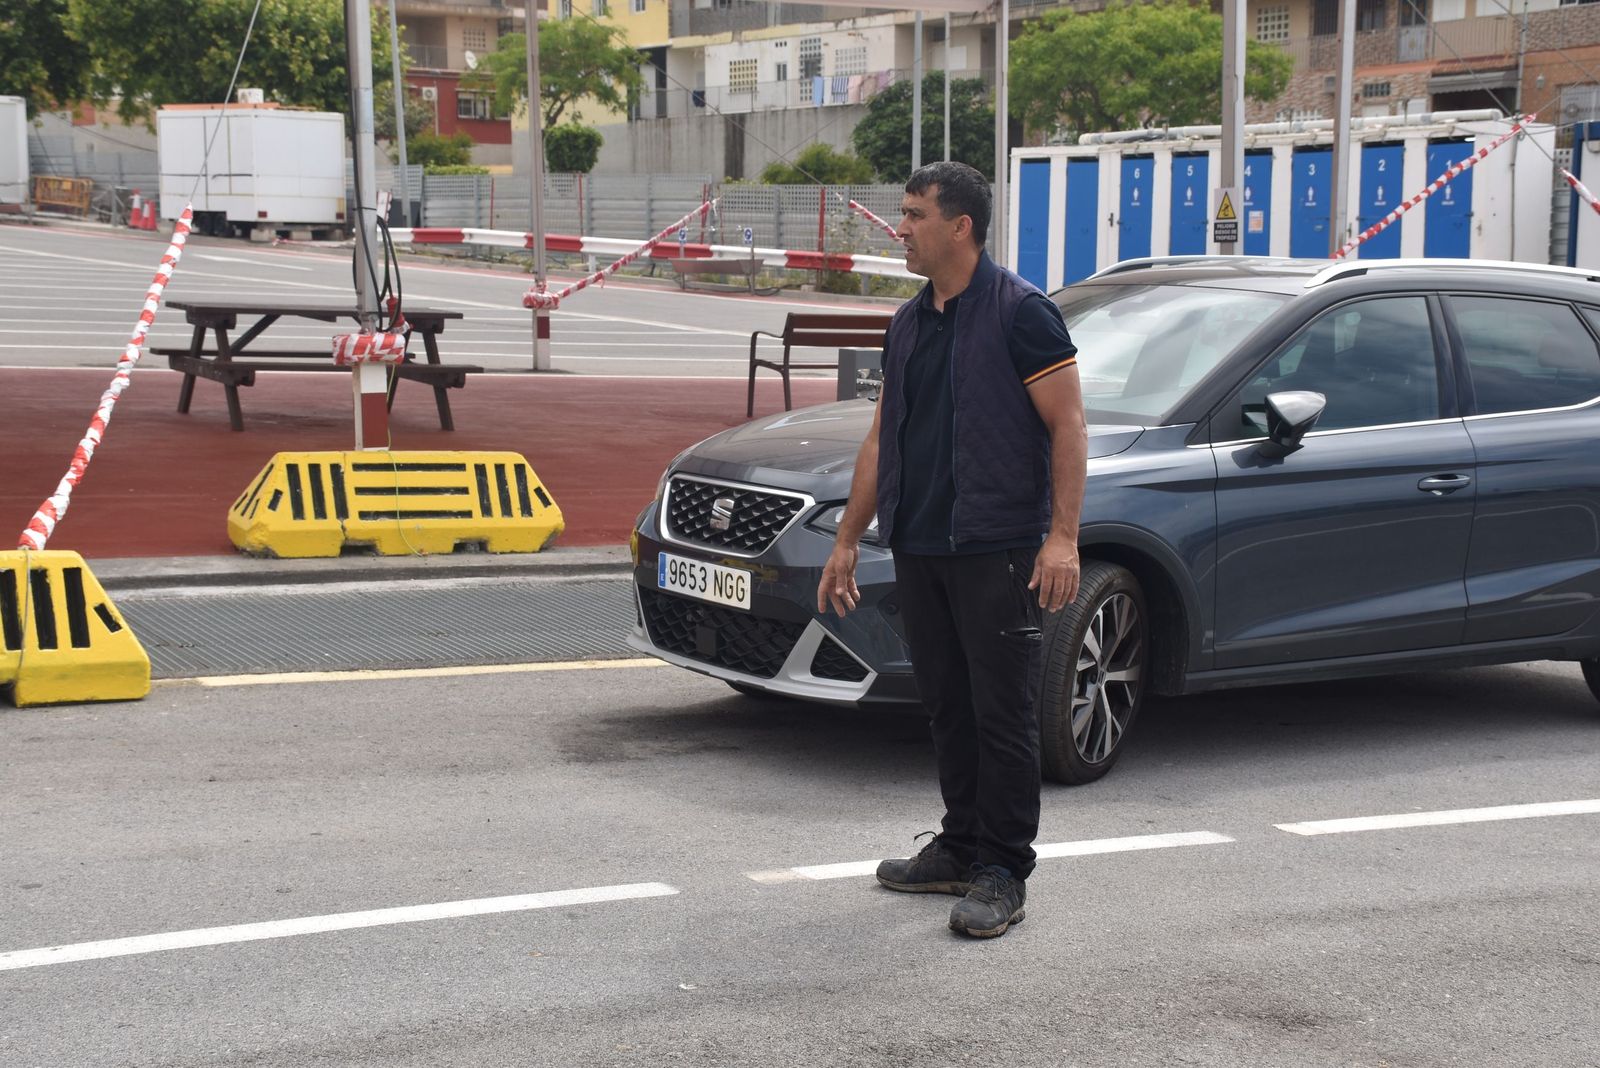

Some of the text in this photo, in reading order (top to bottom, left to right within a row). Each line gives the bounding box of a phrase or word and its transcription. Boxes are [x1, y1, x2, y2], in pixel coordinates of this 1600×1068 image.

[1187, 165, 1194, 176] 5
[1308, 163, 1316, 175] 3
[1378, 159, 1386, 171] 2
[1446, 159, 1452, 170] 1
[1134, 168, 1141, 179] 6
[1244, 165, 1252, 177] 4
[669, 558, 745, 602] 9653 NGG
